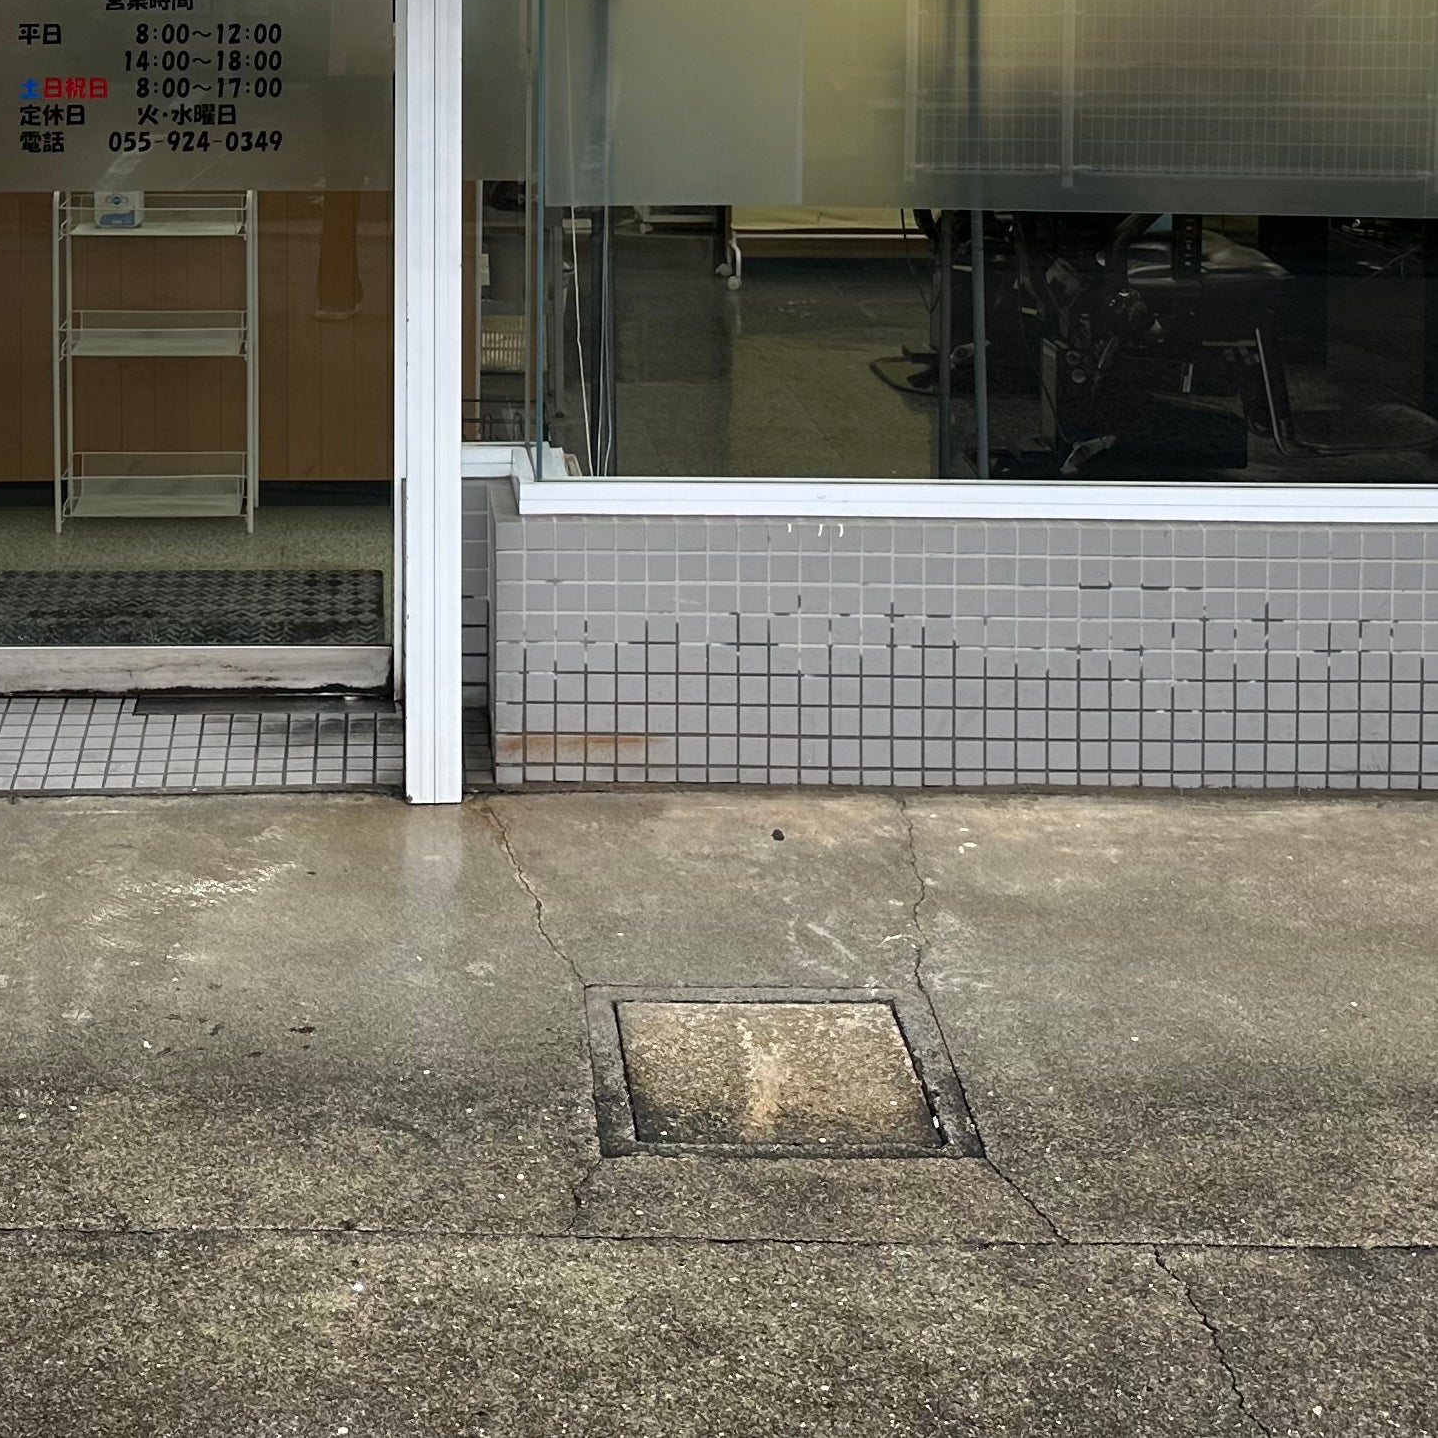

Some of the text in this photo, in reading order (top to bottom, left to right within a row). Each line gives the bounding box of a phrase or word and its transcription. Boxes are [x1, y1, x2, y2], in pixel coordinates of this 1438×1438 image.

[18, 23, 62, 45] 平日
[20, 77, 108, 99] 土日祝日
[20, 104, 237, 126] 定休日 火・水曜日
[20, 130, 283, 153] 電話 055-924-0349
